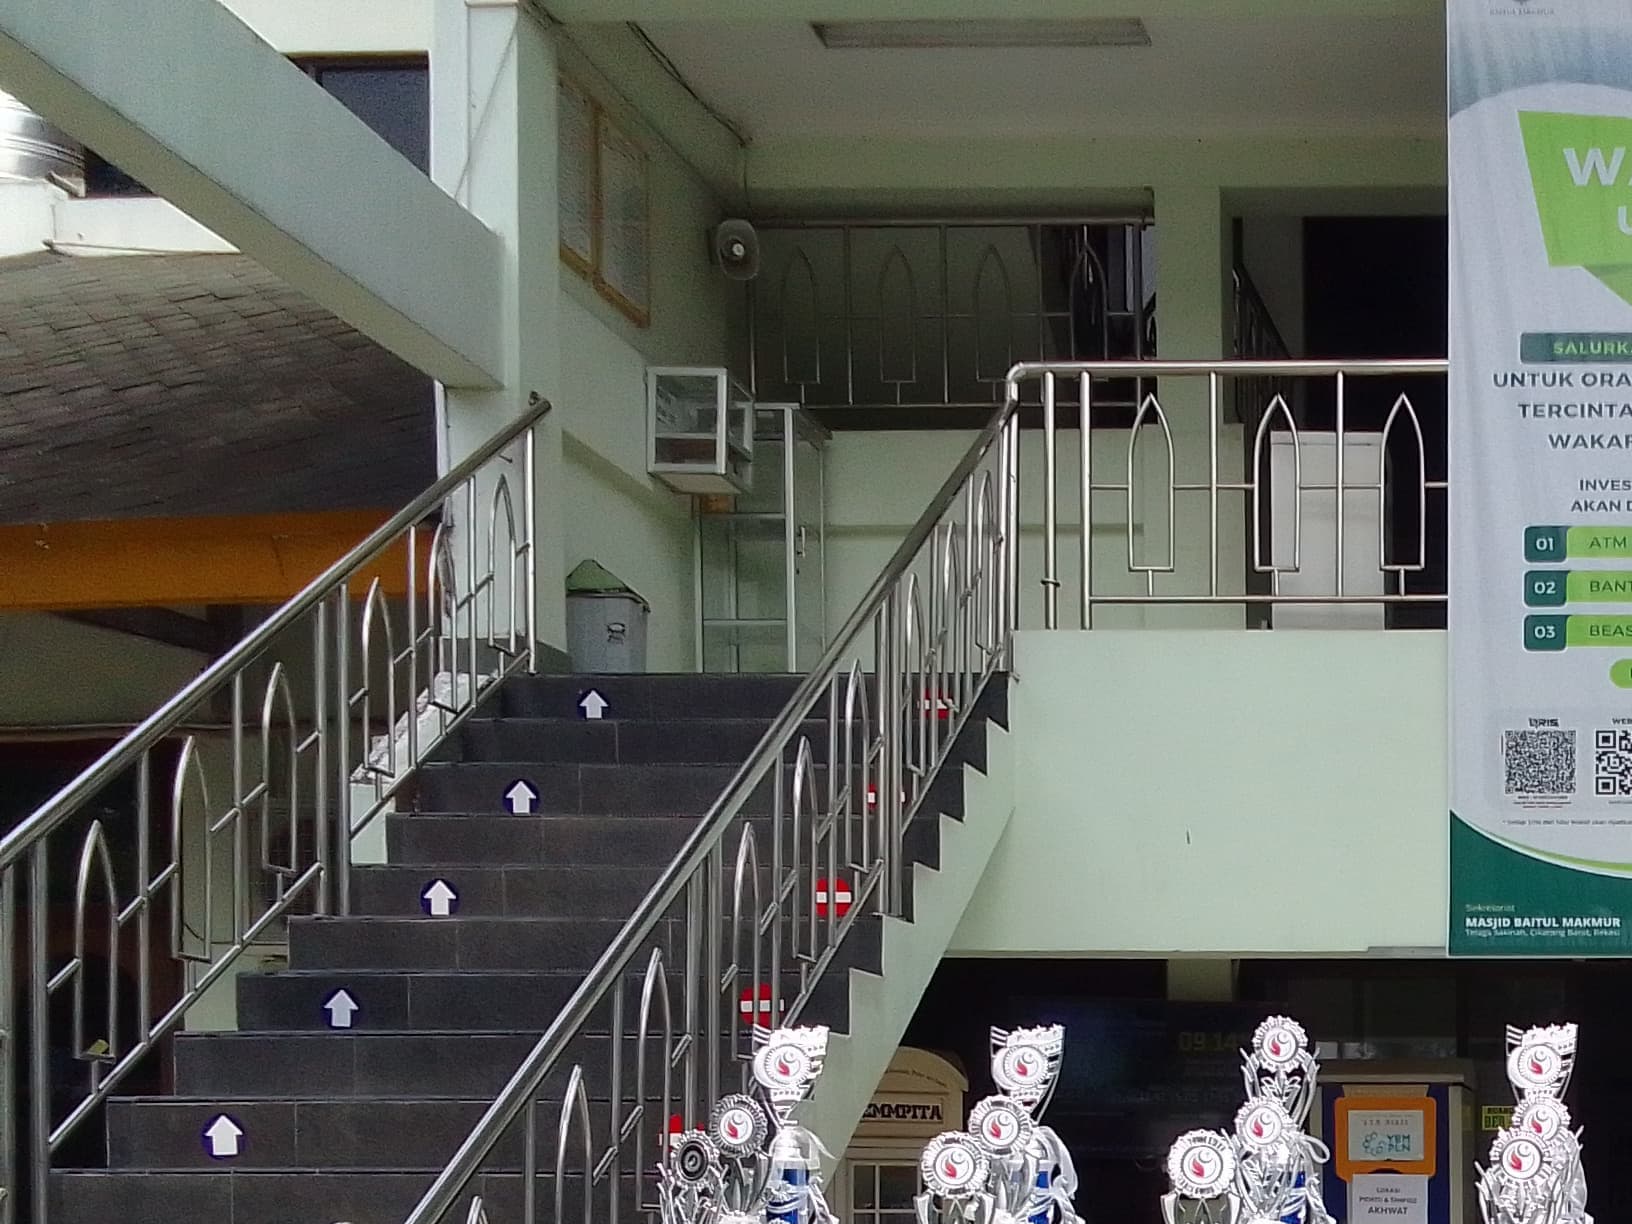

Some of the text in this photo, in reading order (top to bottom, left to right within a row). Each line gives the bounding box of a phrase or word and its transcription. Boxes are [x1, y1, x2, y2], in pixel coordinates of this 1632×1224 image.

[1493, 372, 1573, 388] UNTUK
[1571, 500, 1622, 512] AKAN
[1535, 537, 1554, 551] 01
[1589, 536, 1628, 549] ATM
[1534, 581, 1556, 595] 02
[1534, 625, 1556, 639] 03
[1466, 918, 1621, 929] MASJID BAITUL MAKMUR
